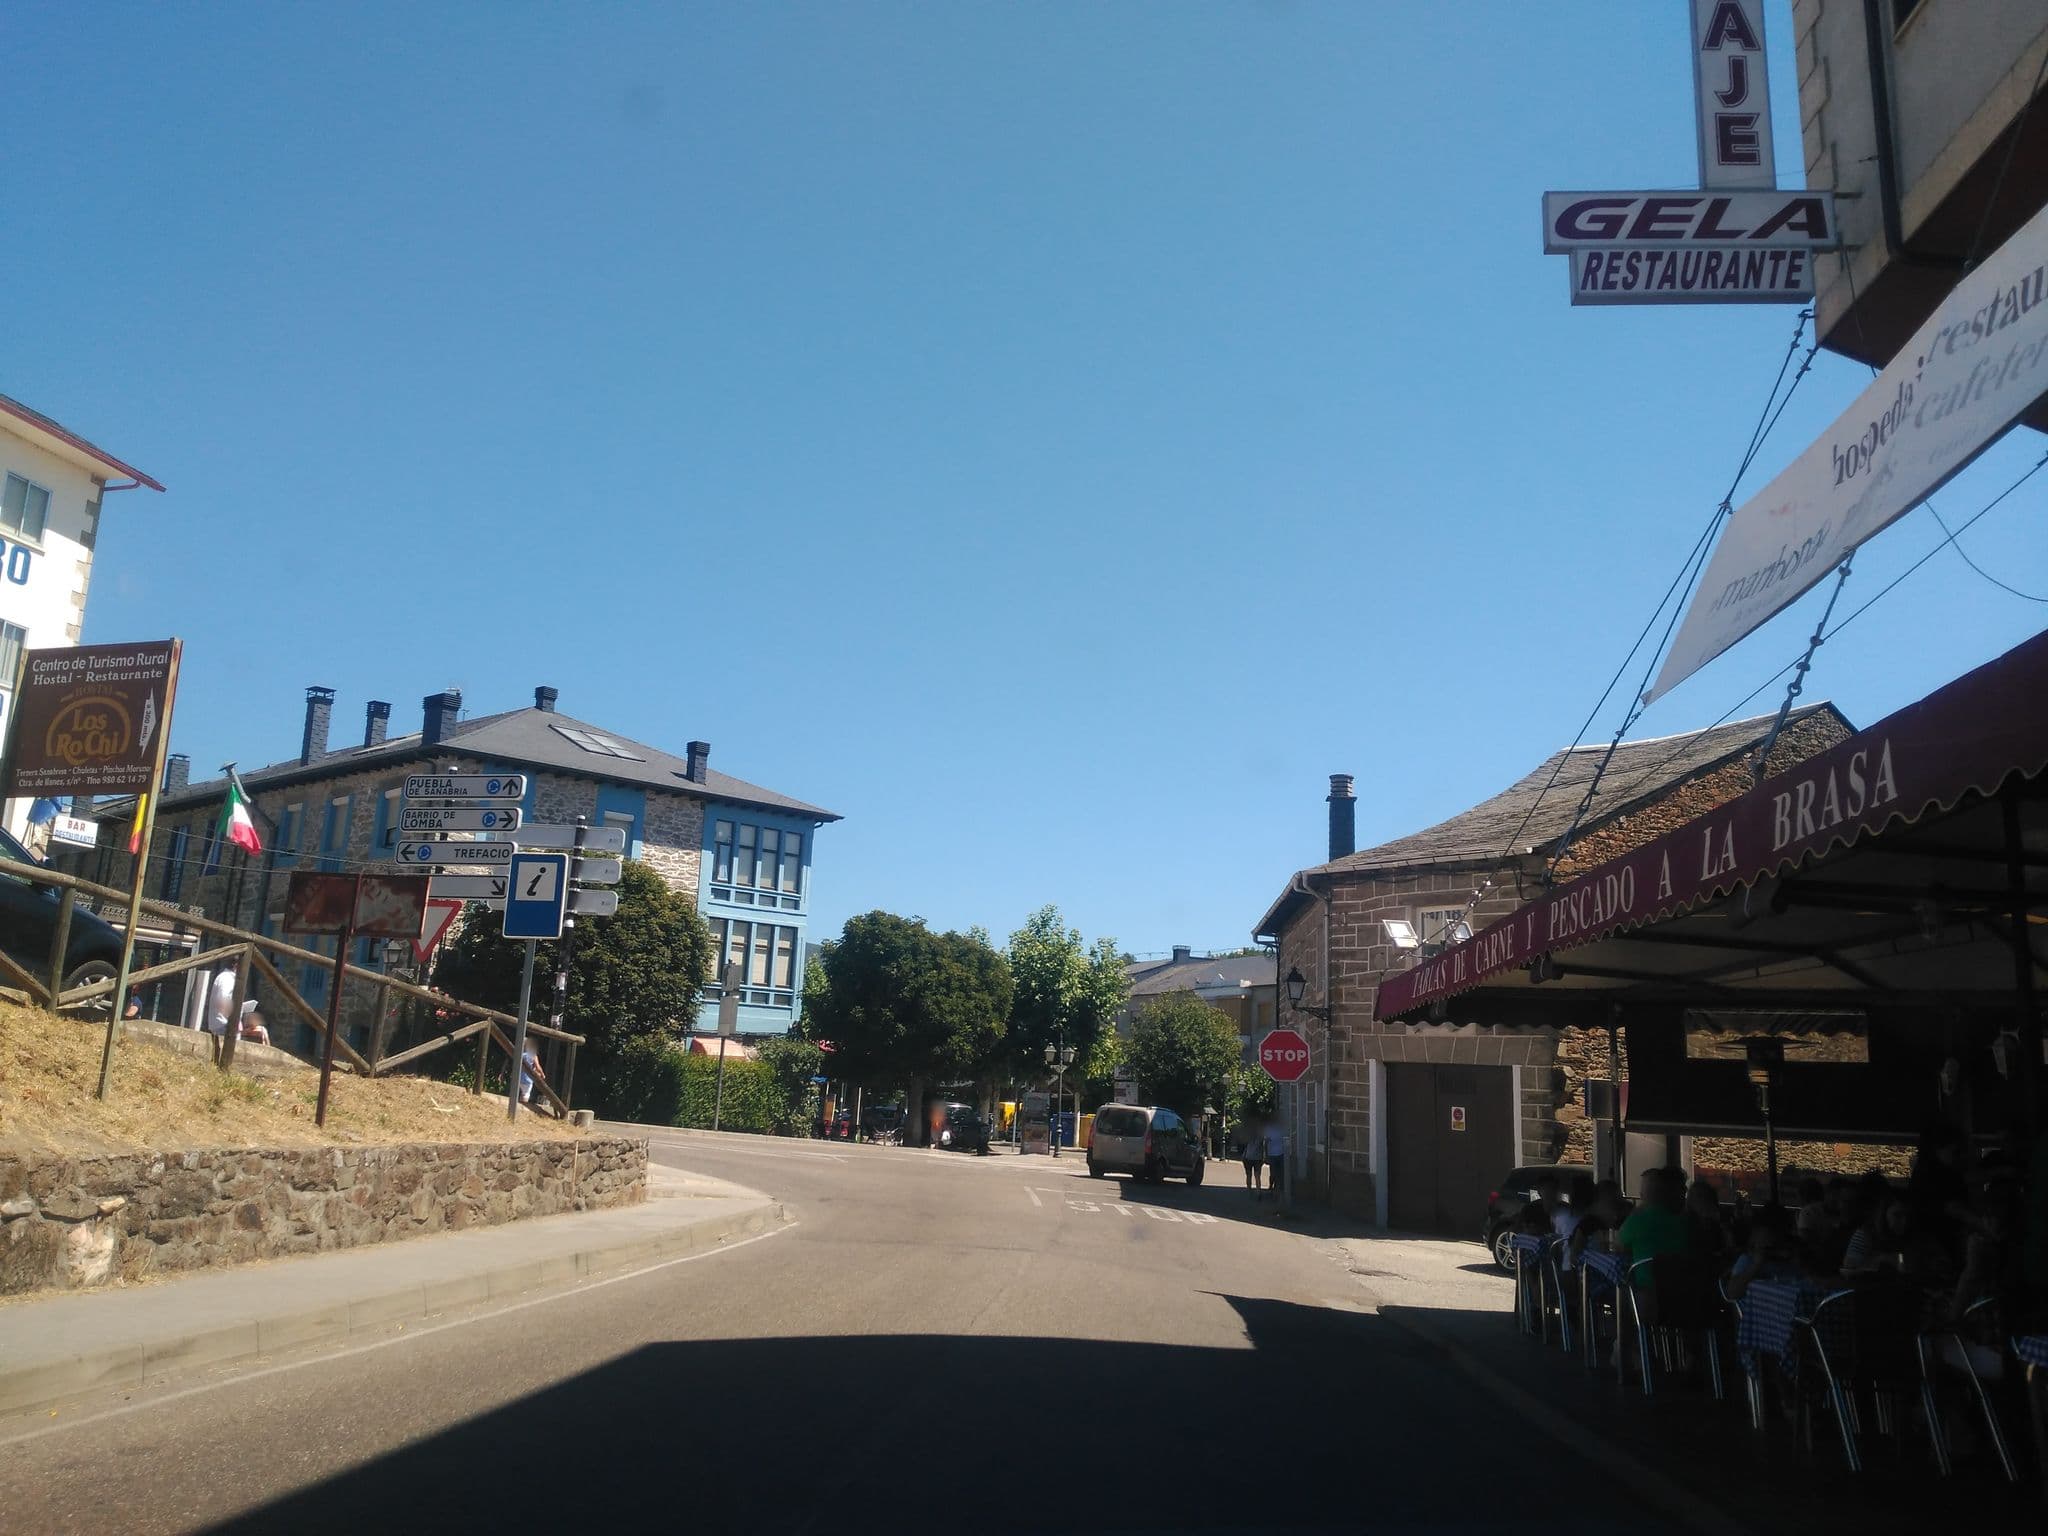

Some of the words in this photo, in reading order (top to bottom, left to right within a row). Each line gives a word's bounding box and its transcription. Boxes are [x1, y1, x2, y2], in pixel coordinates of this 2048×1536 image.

[1554, 198, 1828, 240] GELA
[1580, 250, 1806, 291] RESTAURANTE
[32, 658, 70, 672] Centro
[71, 657, 86, 670] de
[88, 655, 134, 668] Turismo
[136, 651, 168, 666] Rural
[33, 672, 72, 685] Hostal
[85, 668, 163, 682] Restaurante
[71, 708, 108, 731] Los
[34, 778, 44, 786] de
[102, 775, 115, 784] 980
[116, 775, 126, 784] 62
[127, 775, 136, 783] 14
[137, 774, 147, 783] 79
[409, 779, 453, 788] PUEBLA
[408, 788, 422, 796] DE
[424, 788, 468, 796] SANABRIA
[404, 811, 439, 819] BARRIO
[443, 811, 456, 819] DE
[67, 818, 86, 832] BAR
[403, 819, 443, 829] LOMBA
[454, 848, 510, 858] TREFACIO
[1411, 957, 1449, 1000] TABLAS
[1452, 945, 1468, 984] DE
[1473, 921, 1515, 975] CARNE
[1525, 910, 1537, 951] Y
[1548, 863, 1636, 942] PESCADO
[1656, 848, 1673, 900] A
[1700, 818, 1737, 881] LA
[1771, 737, 1900, 852] BRASA
[1263, 1049, 1307, 1062] STOP
[1064, 1199, 1220, 1224] STOP
